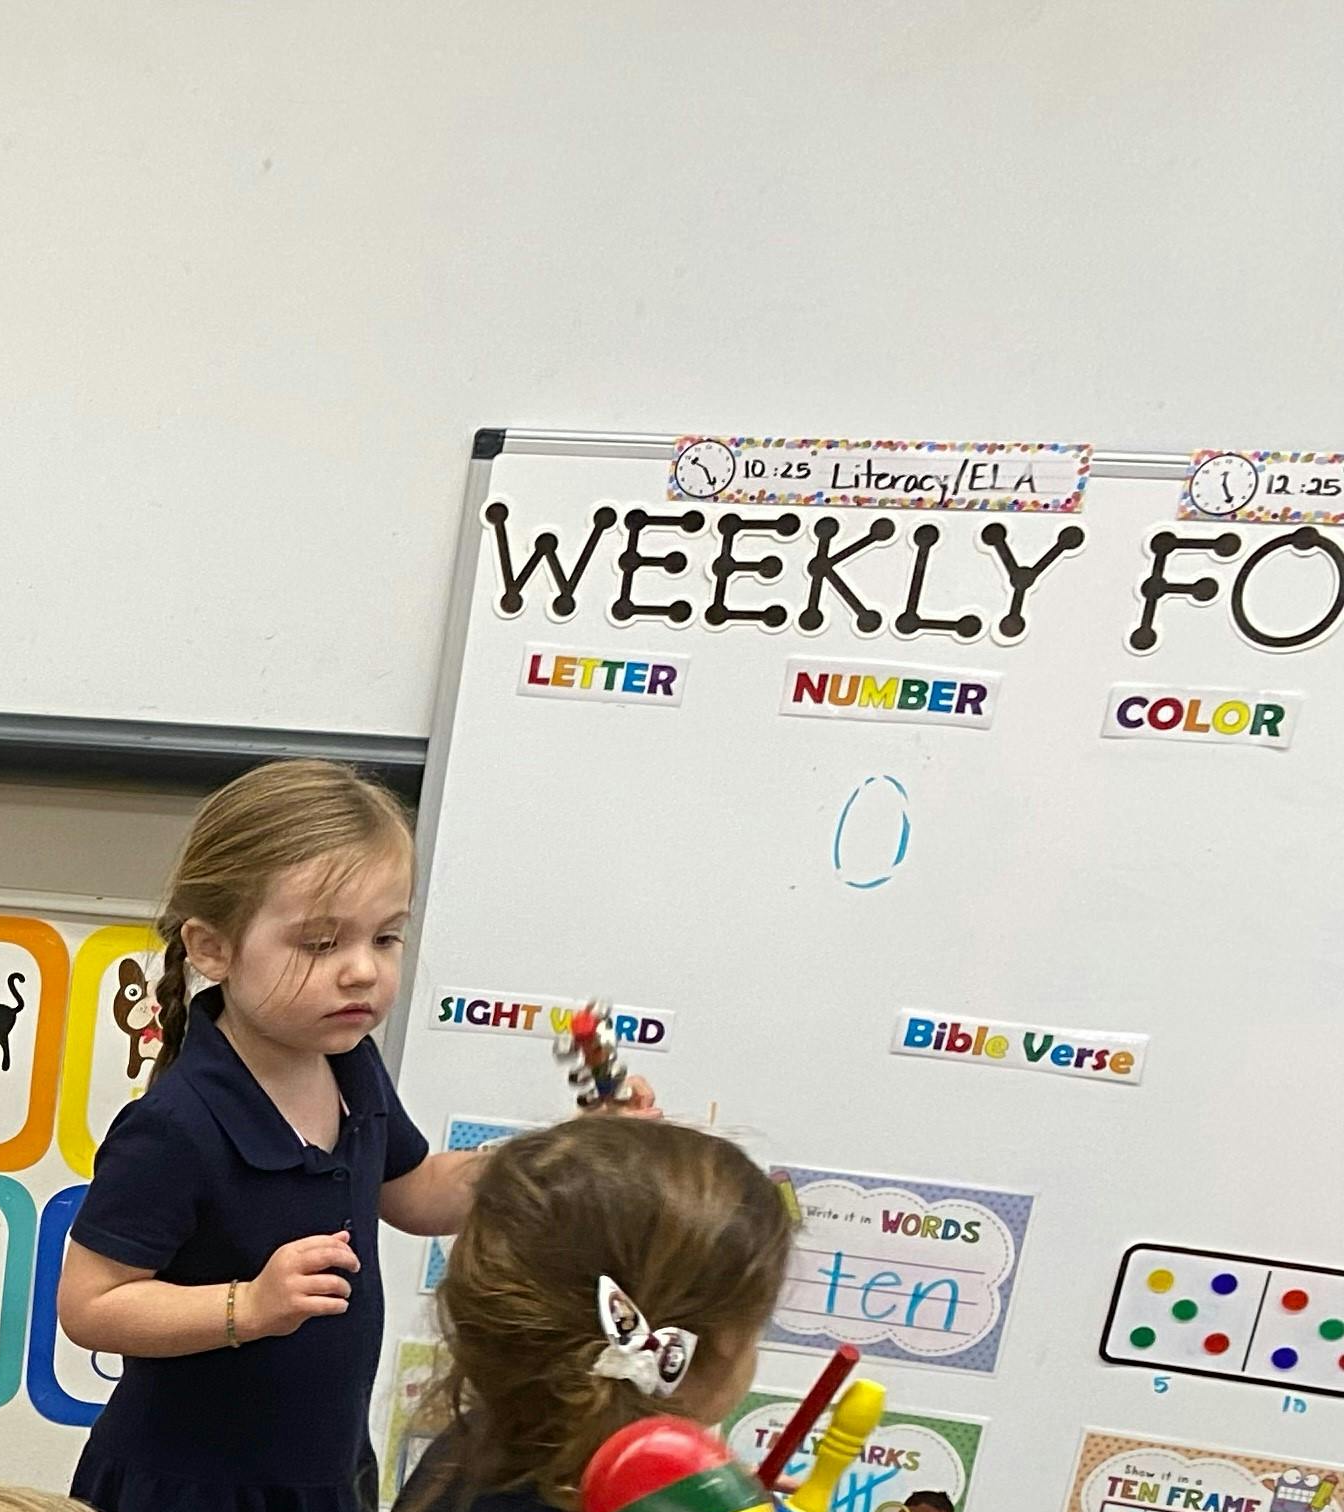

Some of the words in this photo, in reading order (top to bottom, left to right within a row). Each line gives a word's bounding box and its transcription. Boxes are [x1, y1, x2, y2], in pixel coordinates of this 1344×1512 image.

[744, 460, 811, 479] 10:25
[1266, 474, 1342, 496] 12:25
[486, 503, 1085, 637] WEEKLY
[528, 652, 678, 697] LETTER
[792, 671, 988, 716] NUMBER
[1116, 695, 1285, 738] COLOR
[438, 996, 542, 1031] SIGHT
[549, 1007, 666, 1044] WRD
[903, 1017, 1009, 1060] Bible
[1023, 1032, 1135, 1075] Verse
[806, 1205, 839, 1220] Write
[844, 1210, 855, 1222] it
[860, 1213, 872, 1225] in
[881, 1209, 981, 1244] WORDS
[817, 1251, 960, 1332] ten
[1153, 1376, 1172, 1393] 5
[1282, 1396, 1307, 1413] 10
[754, 1428, 824, 1456] TLY
[860, 1444, 921, 1471] RKS
[1107, 1476, 1160, 1504] TEN
[1124, 1464, 1155, 1478] Show
[1160, 1471, 1172, 1481] it
[1177, 1474, 1189, 1485] in
